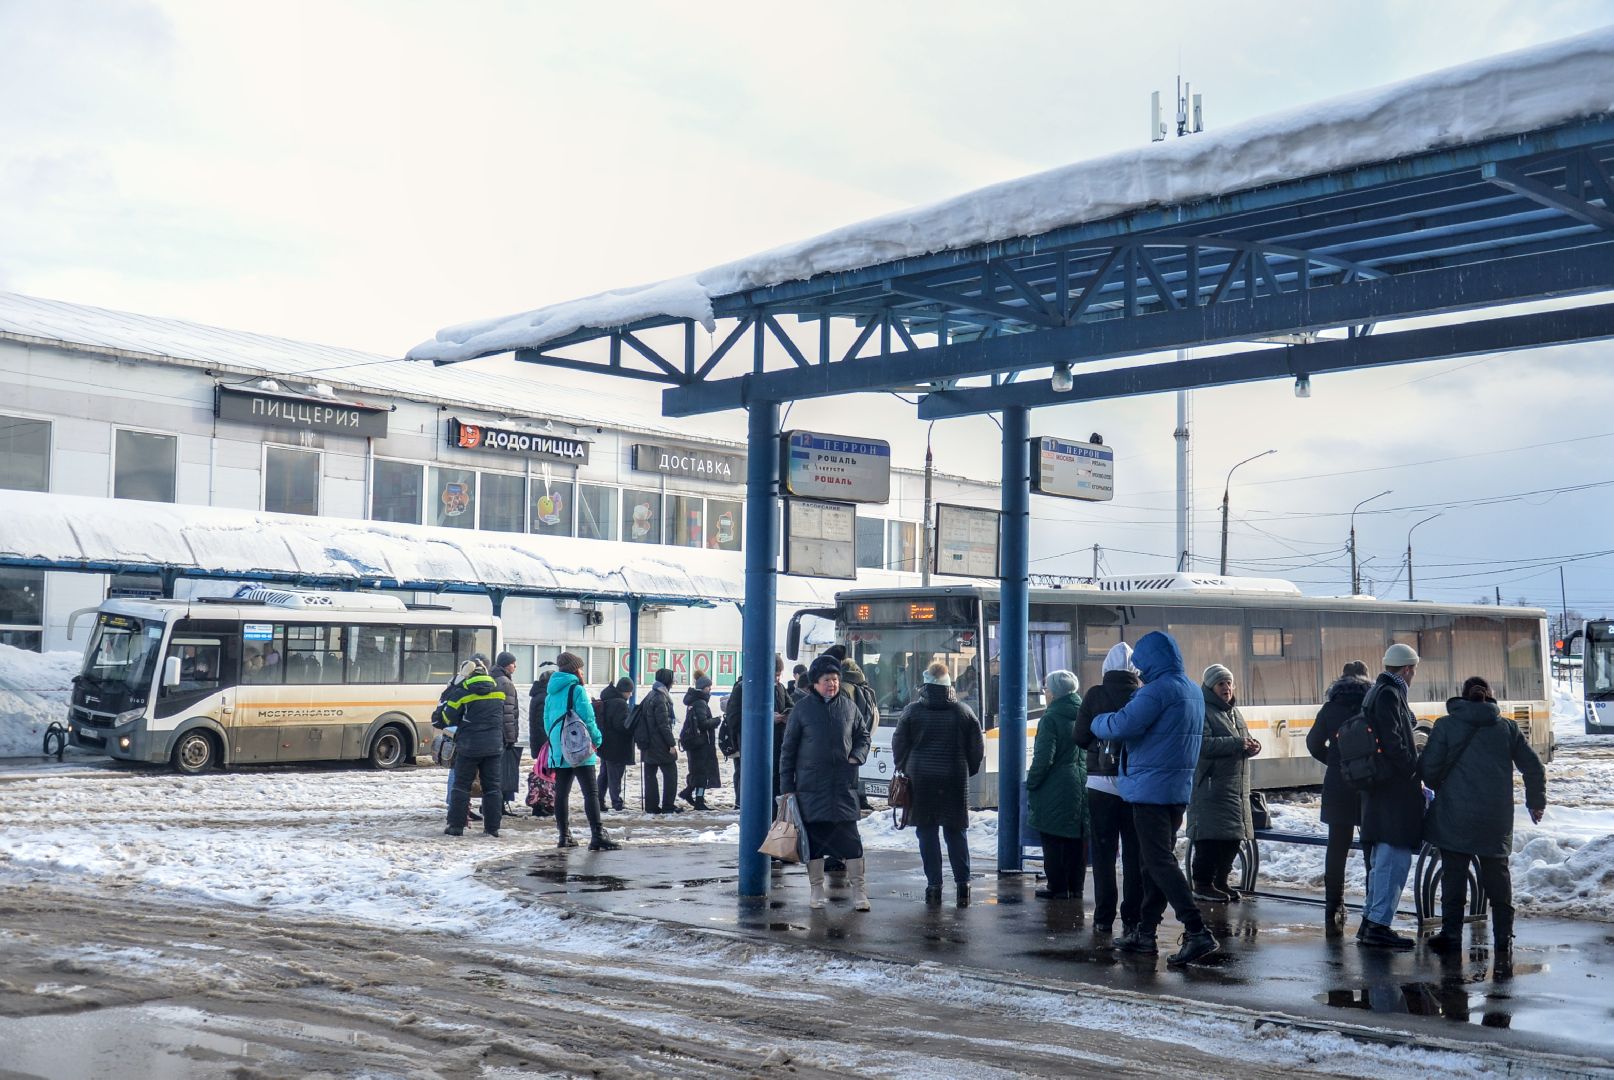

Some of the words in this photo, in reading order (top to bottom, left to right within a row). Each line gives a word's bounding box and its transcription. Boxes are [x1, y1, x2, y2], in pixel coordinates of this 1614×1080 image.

[252, 398, 360, 428] ПИЦЦЕРИЯ
[485, 431, 530, 451] ДОДО
[532, 438, 585, 458] ПИЦЦА
[823, 440, 877, 455] ПЕРРОН
[1066, 446, 1100, 458] ПЕРРОН
[659, 454, 731, 475] ДОСТАВКА
[817, 454, 857, 465] РОШАЛЬ
[814, 475, 852, 485] РОШАЛЬ
[258, 709, 344, 718] МОСТРАНСАВТО
